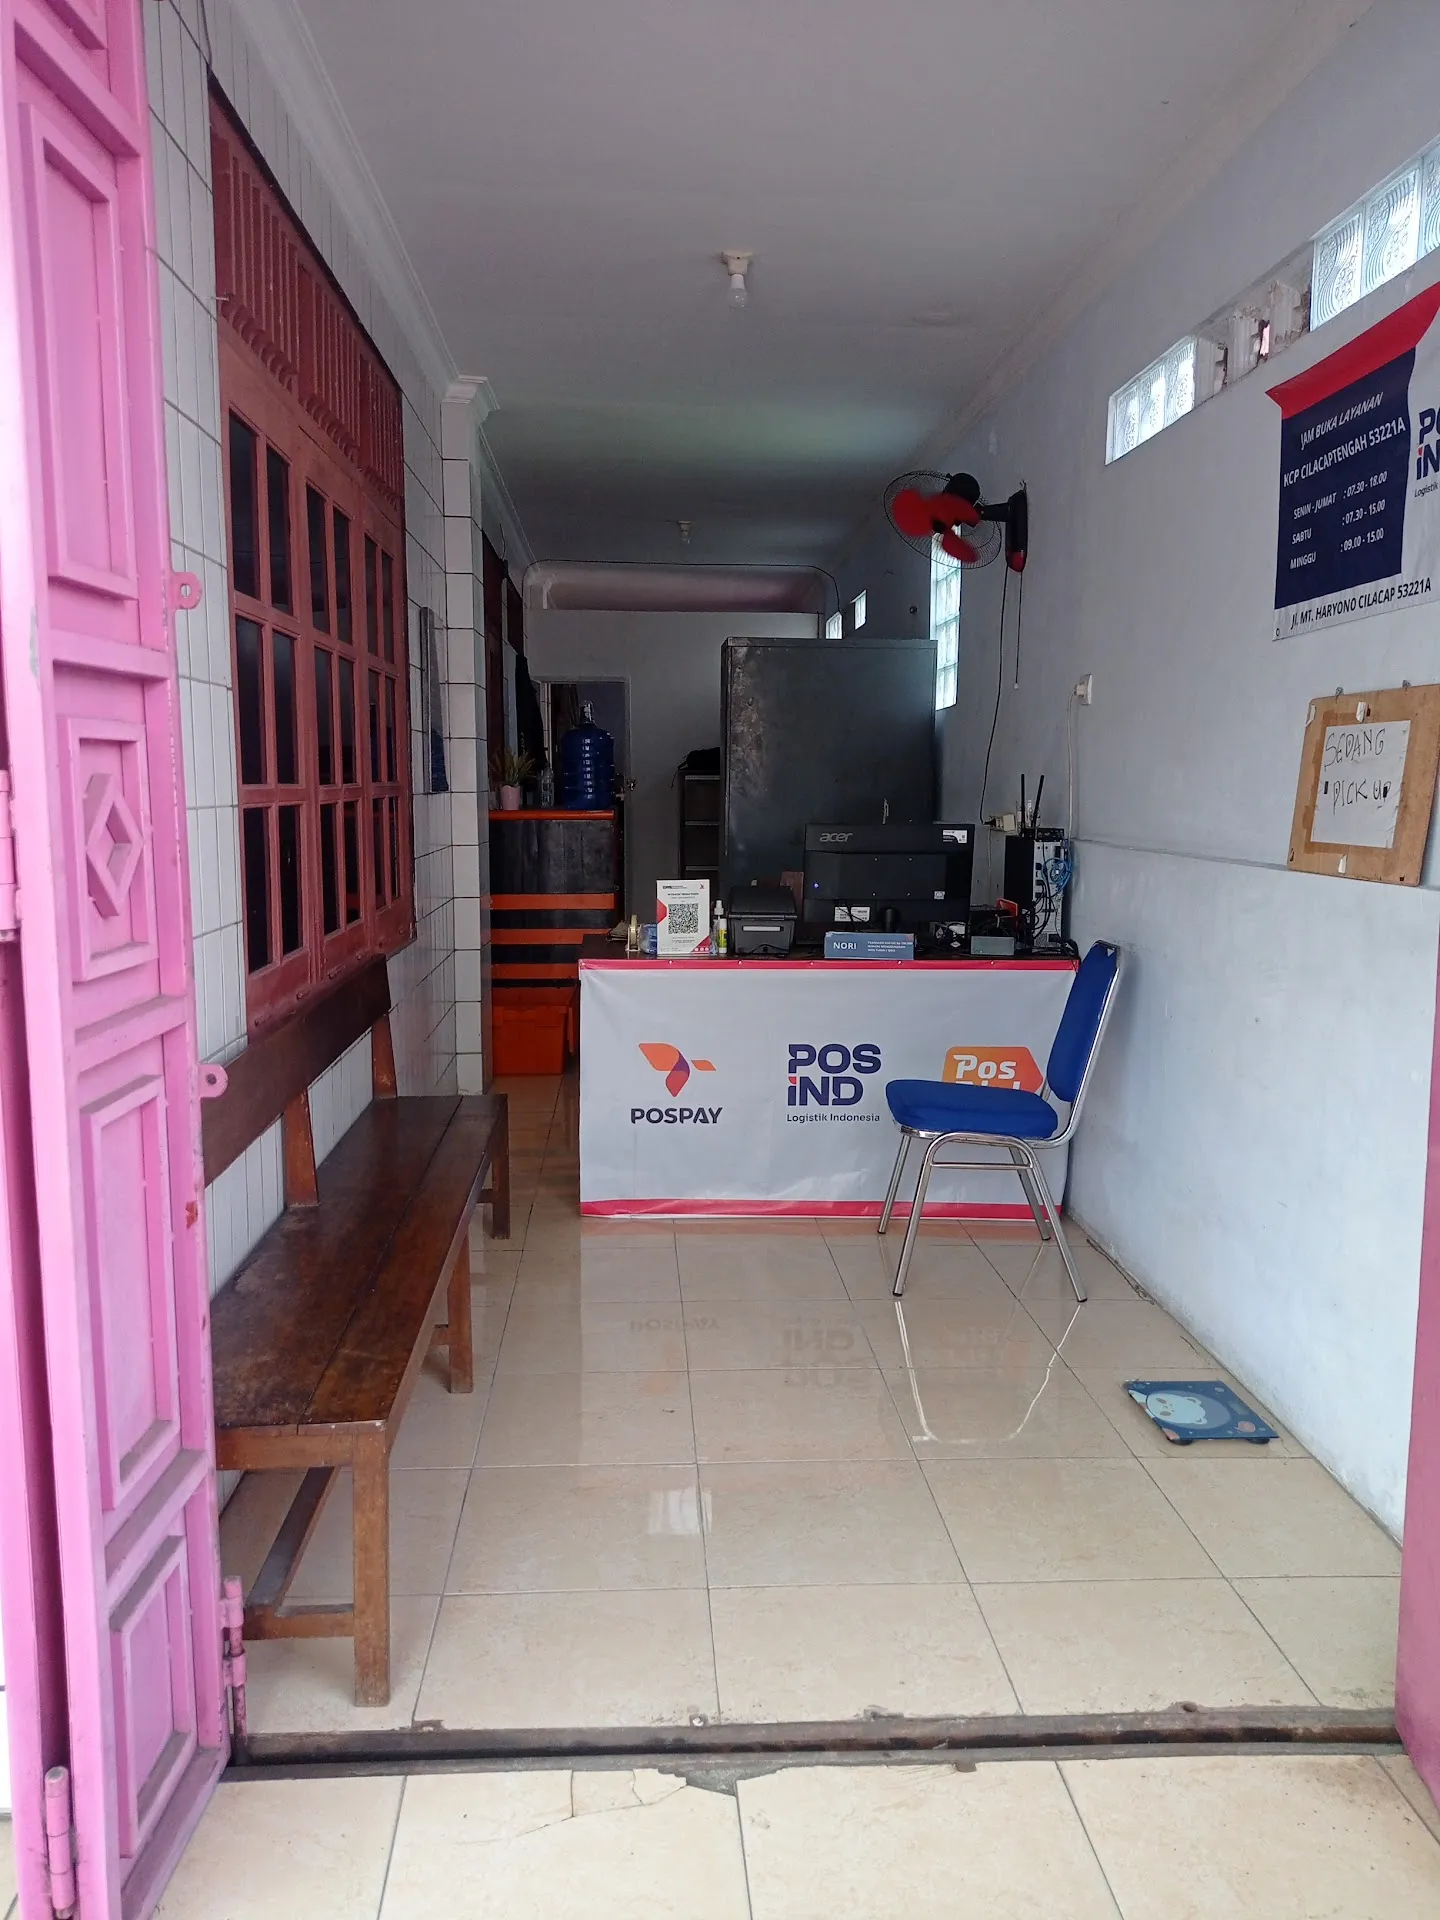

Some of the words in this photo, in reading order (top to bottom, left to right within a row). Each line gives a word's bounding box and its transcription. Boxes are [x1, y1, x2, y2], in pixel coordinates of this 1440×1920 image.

[1300, 428, 1315, 451] JAM
[1315, 415, 1338, 438] BUKA
[1338, 392, 1384, 426] LAYANAN
[1283, 468, 1300, 488] KCP
[1300, 433, 1368, 480] CILACAPTENGAH
[1368, 416, 1406, 447] 53221A
[1414, 481, 1439, 498] Logistik
[1293, 502, 1312, 520] SENIN
[1313, 491, 1338, 514] JUMAT
[1368, 498, 1386, 516] 15.00
[1291, 527, 1312, 545] SABTU
[1366, 527, 1385, 544] 15.00
[1289, 551, 1317, 570] MINGGU
[1299, 608, 1314, 625] MT.
[1315, 597, 1357, 621] HARYONO
[1358, 586, 1396, 610] CILACAP
[1397, 576, 1432, 600] 53221A
[1323, 727, 1386, 772] SEDANG
[1331, 777, 1368, 816] PICK
[819, 831, 854, 843] acer
[833, 942, 857, 950] NORI
[787, 1043, 882, 1075] POS
[952, 1054, 1018, 1080] Pos
[630, 1106, 724, 1125] POSPAY
[786, 1112, 828, 1124] Logistik
[830, 1112, 881, 1123] Indonesia
